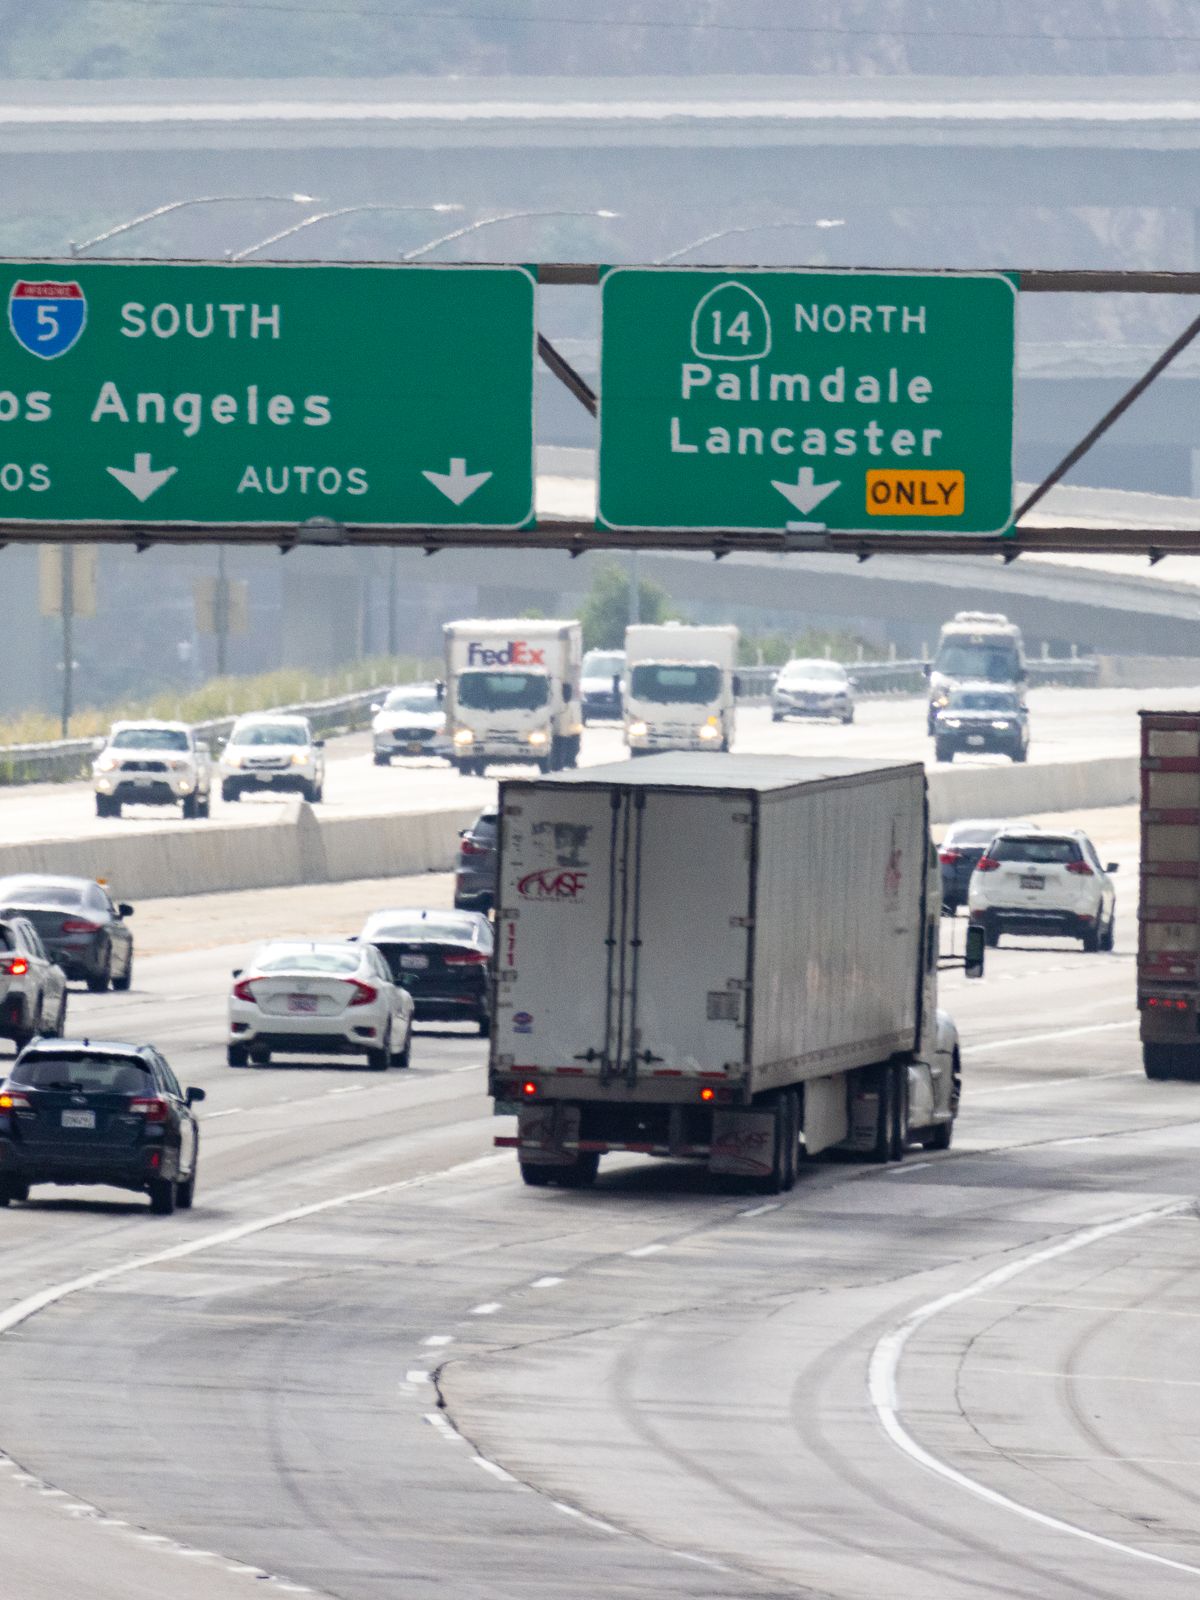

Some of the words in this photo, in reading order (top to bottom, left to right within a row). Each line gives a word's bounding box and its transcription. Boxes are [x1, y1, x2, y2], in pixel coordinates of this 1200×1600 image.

[36, 305, 59, 341] 5
[120, 302, 281, 339] SOUTH
[711, 310, 751, 345] 14
[794, 304, 927, 334] NORTH
[681, 363, 934, 404] Palmdale
[90, 381, 332, 437] Angeles
[670, 417, 943, 457] Lancaster
[236, 465, 369, 495] AUTOS
[871, 481, 958, 506] ONLY
[468, 641, 545, 665] FedEx
